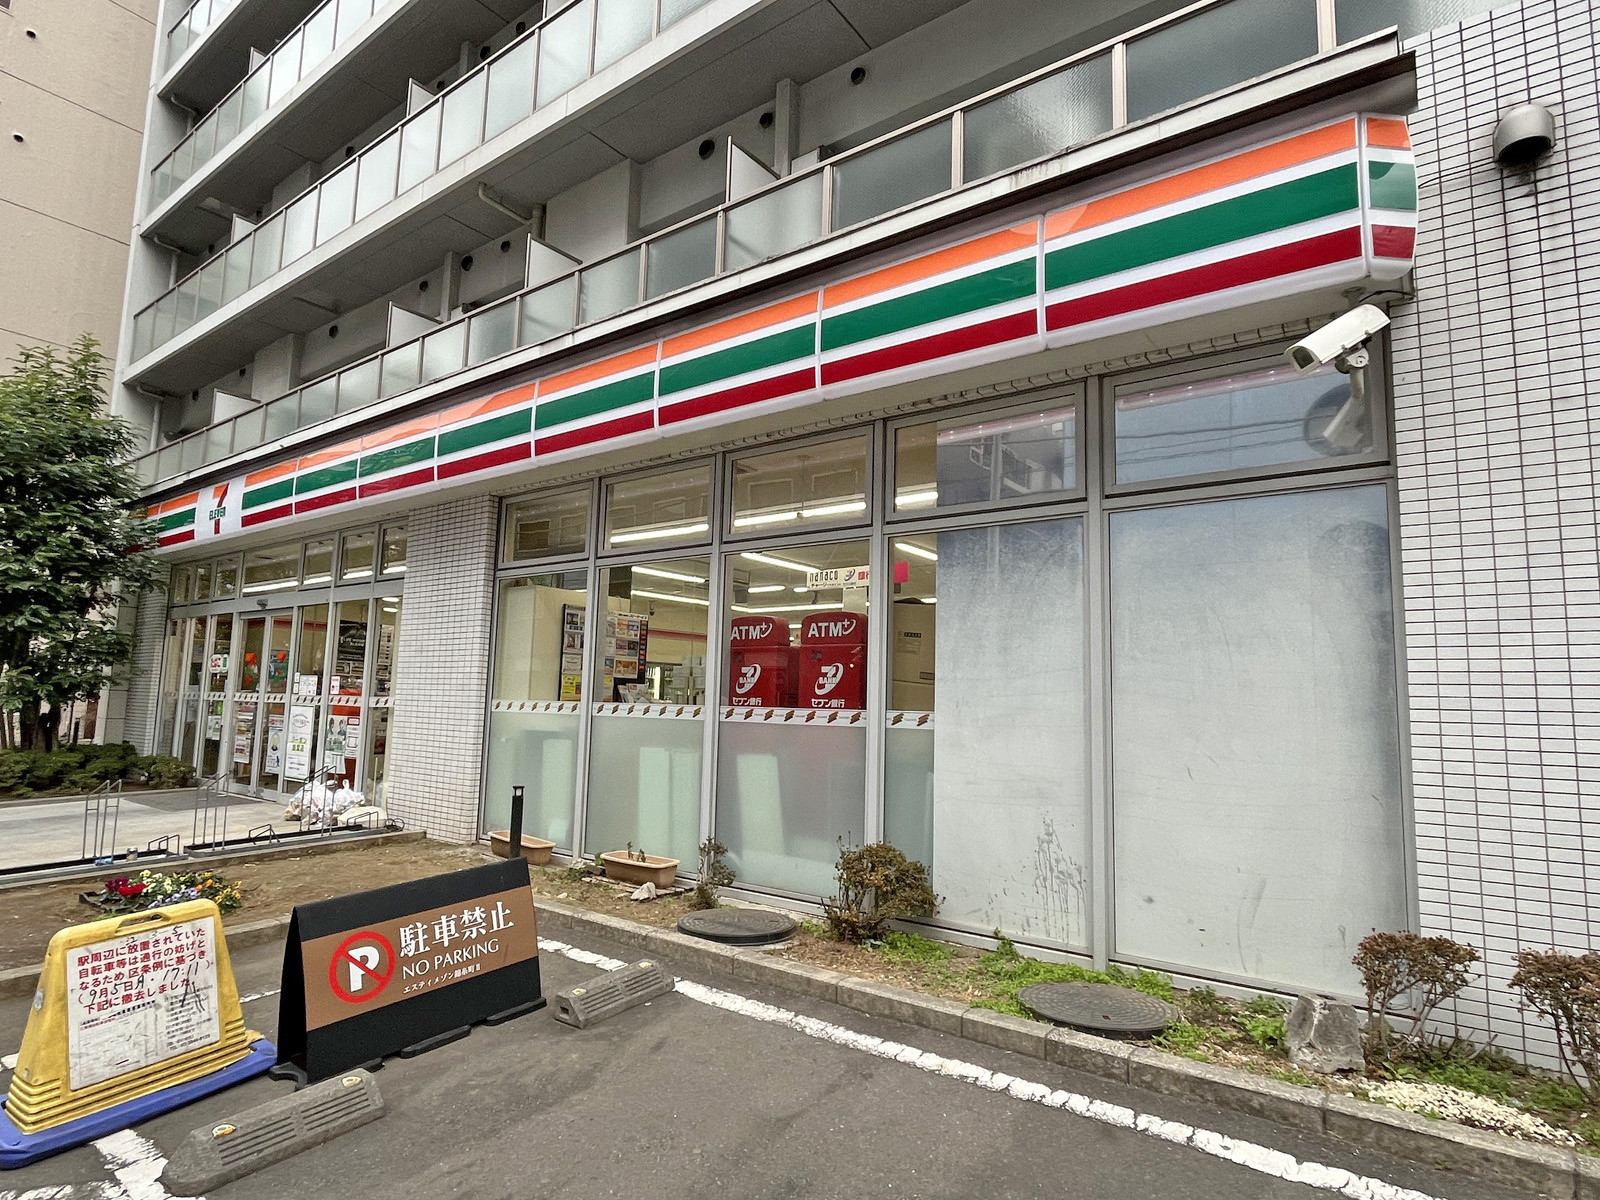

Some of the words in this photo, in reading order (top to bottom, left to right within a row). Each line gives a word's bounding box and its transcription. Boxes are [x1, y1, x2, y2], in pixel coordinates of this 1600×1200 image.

[809, 570, 839, 582] nanaco
[811, 698, 845, 708] セブン銀行
[77, 928, 206, 967] 駅周辺に放置されていた
[399, 900, 515, 958] 駐車禁止
[79, 941, 206, 979] 自転車等は通行の妨げと
[402, 959, 430, 980] NO
[434, 938, 500, 970] PARKING
